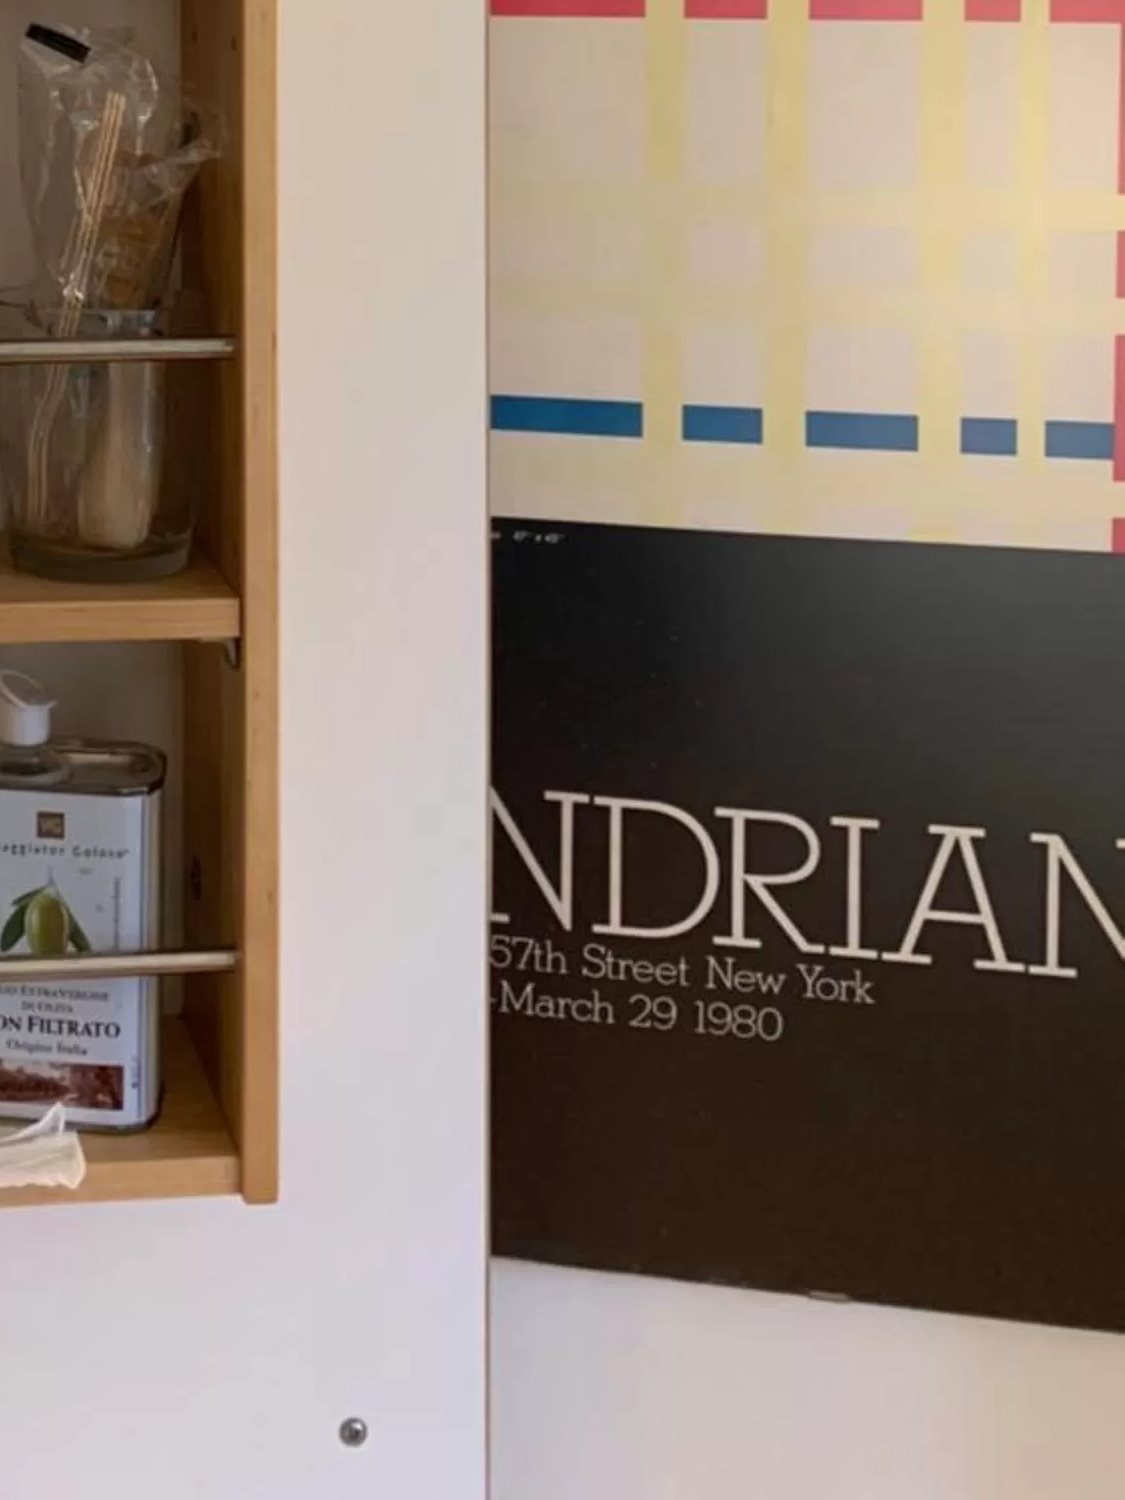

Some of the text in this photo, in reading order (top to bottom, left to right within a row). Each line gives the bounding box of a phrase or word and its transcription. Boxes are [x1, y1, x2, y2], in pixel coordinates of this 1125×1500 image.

[488, 934, 875, 1005] 57th Street New York
[27, 1017, 121, 1040] FILTRATO
[628, 994, 678, 1030] 29
[694, 1001, 784, 1042] 1980
